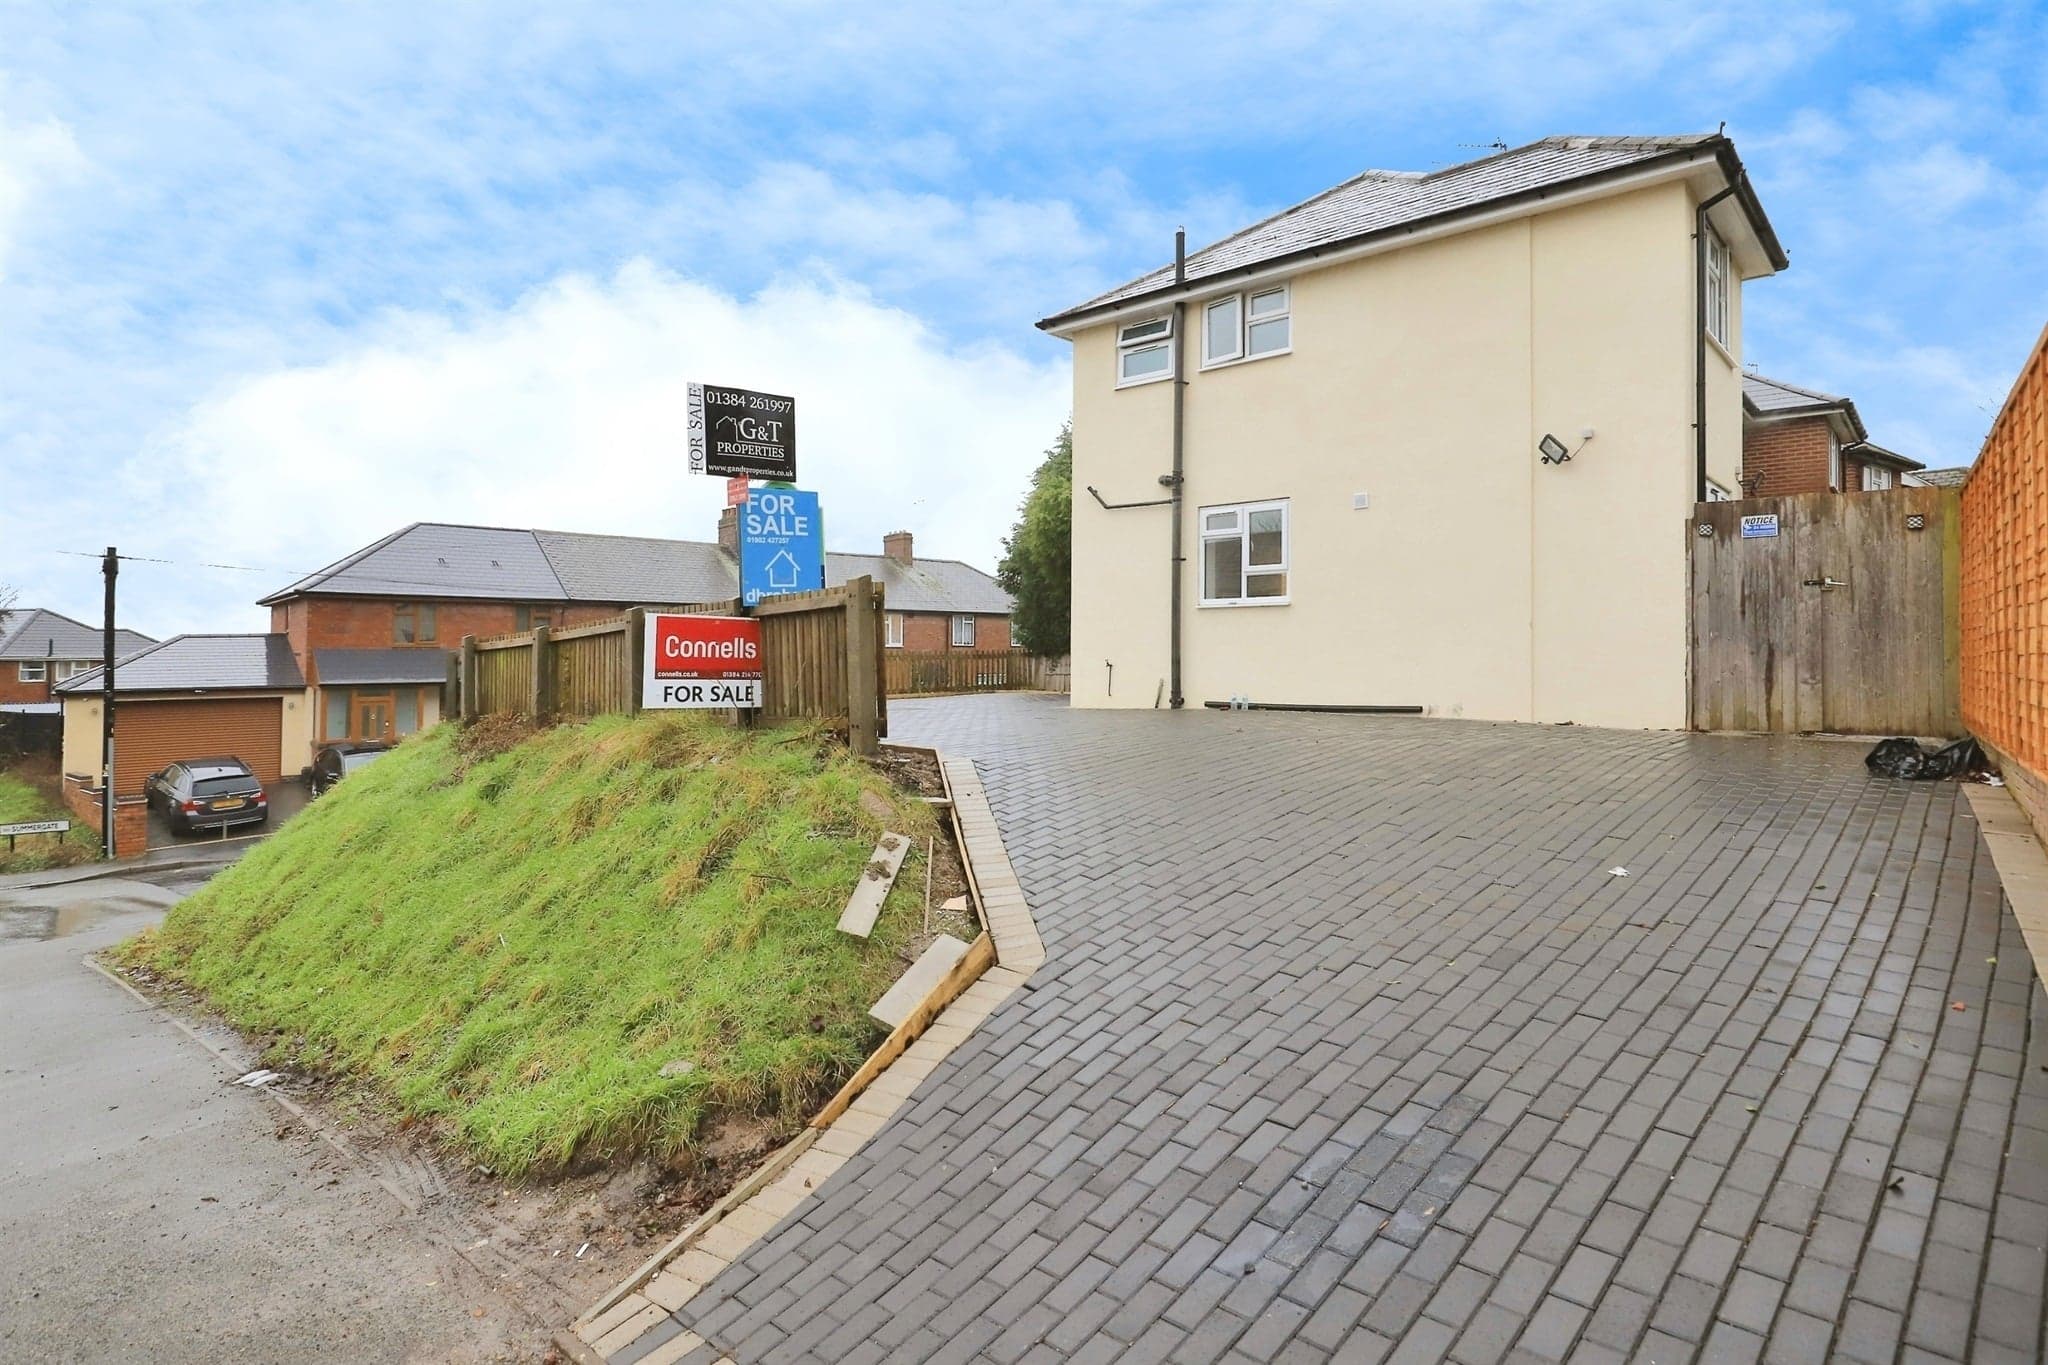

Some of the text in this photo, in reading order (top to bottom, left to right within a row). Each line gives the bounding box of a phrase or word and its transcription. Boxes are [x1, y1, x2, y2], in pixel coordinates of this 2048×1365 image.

[706, 391, 792, 414] 01384 261997
[688, 386, 704, 474] FOR SALE
[740, 417, 783, 442] G&T
[717, 441, 785, 458] PROPERTIES
[746, 493, 796, 515] FOR
[746, 515, 809, 537] SALE
[1744, 516, 1775, 525] NOTICE
[665, 635, 757, 659] Connells
[663, 686, 755, 702] FOR SALE
